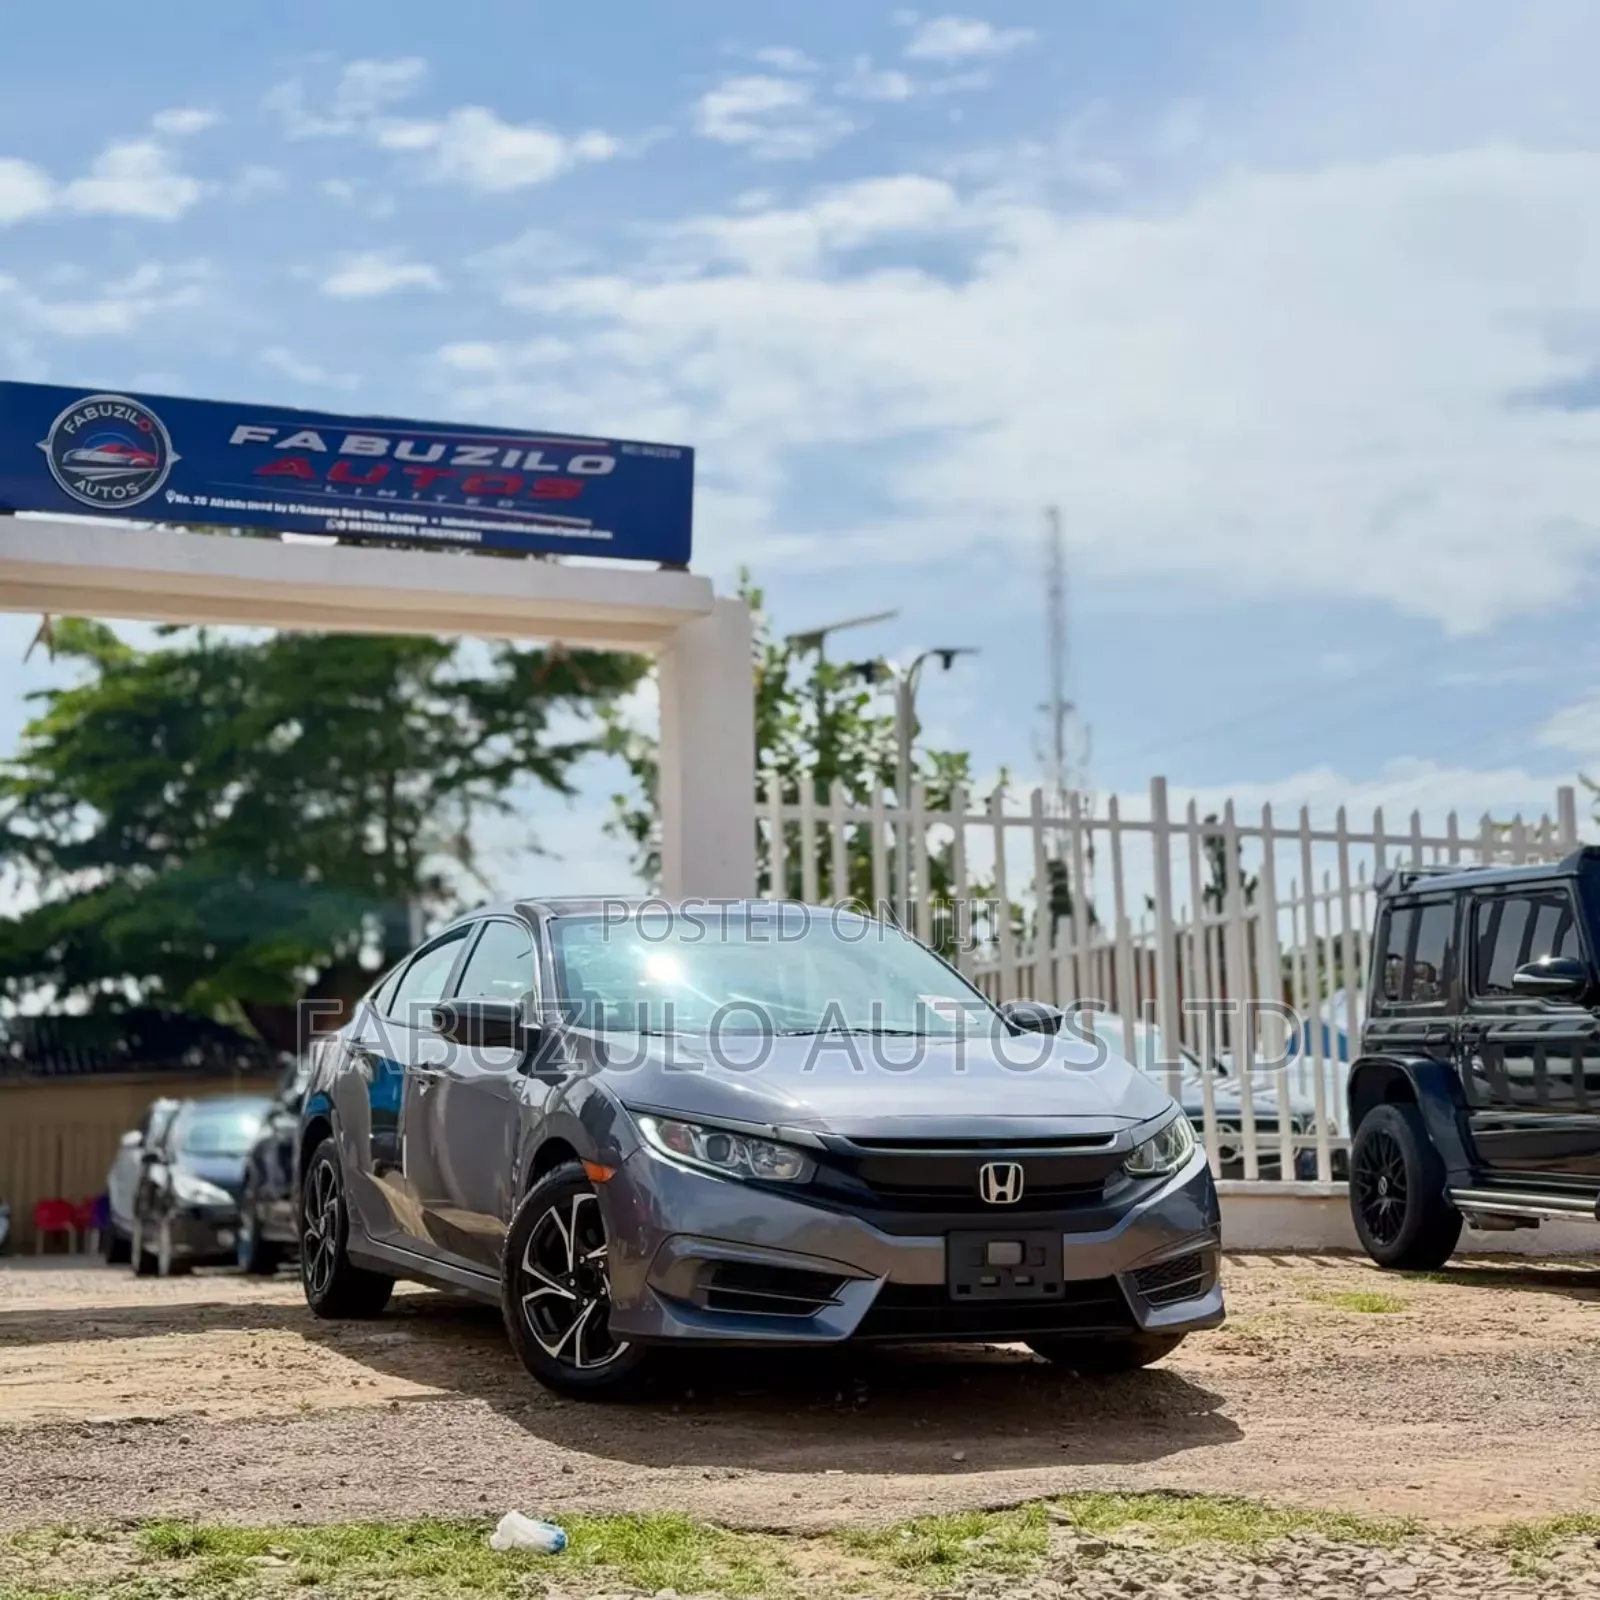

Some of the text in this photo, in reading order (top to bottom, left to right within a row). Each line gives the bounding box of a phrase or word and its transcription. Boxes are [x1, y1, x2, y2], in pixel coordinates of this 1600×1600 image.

[63, 404, 153, 435] FABUZILO
[229, 424, 616, 475] FABUZILO
[73, 479, 140, 500] AUTOS
[252, 456, 587, 500] AUTOS
